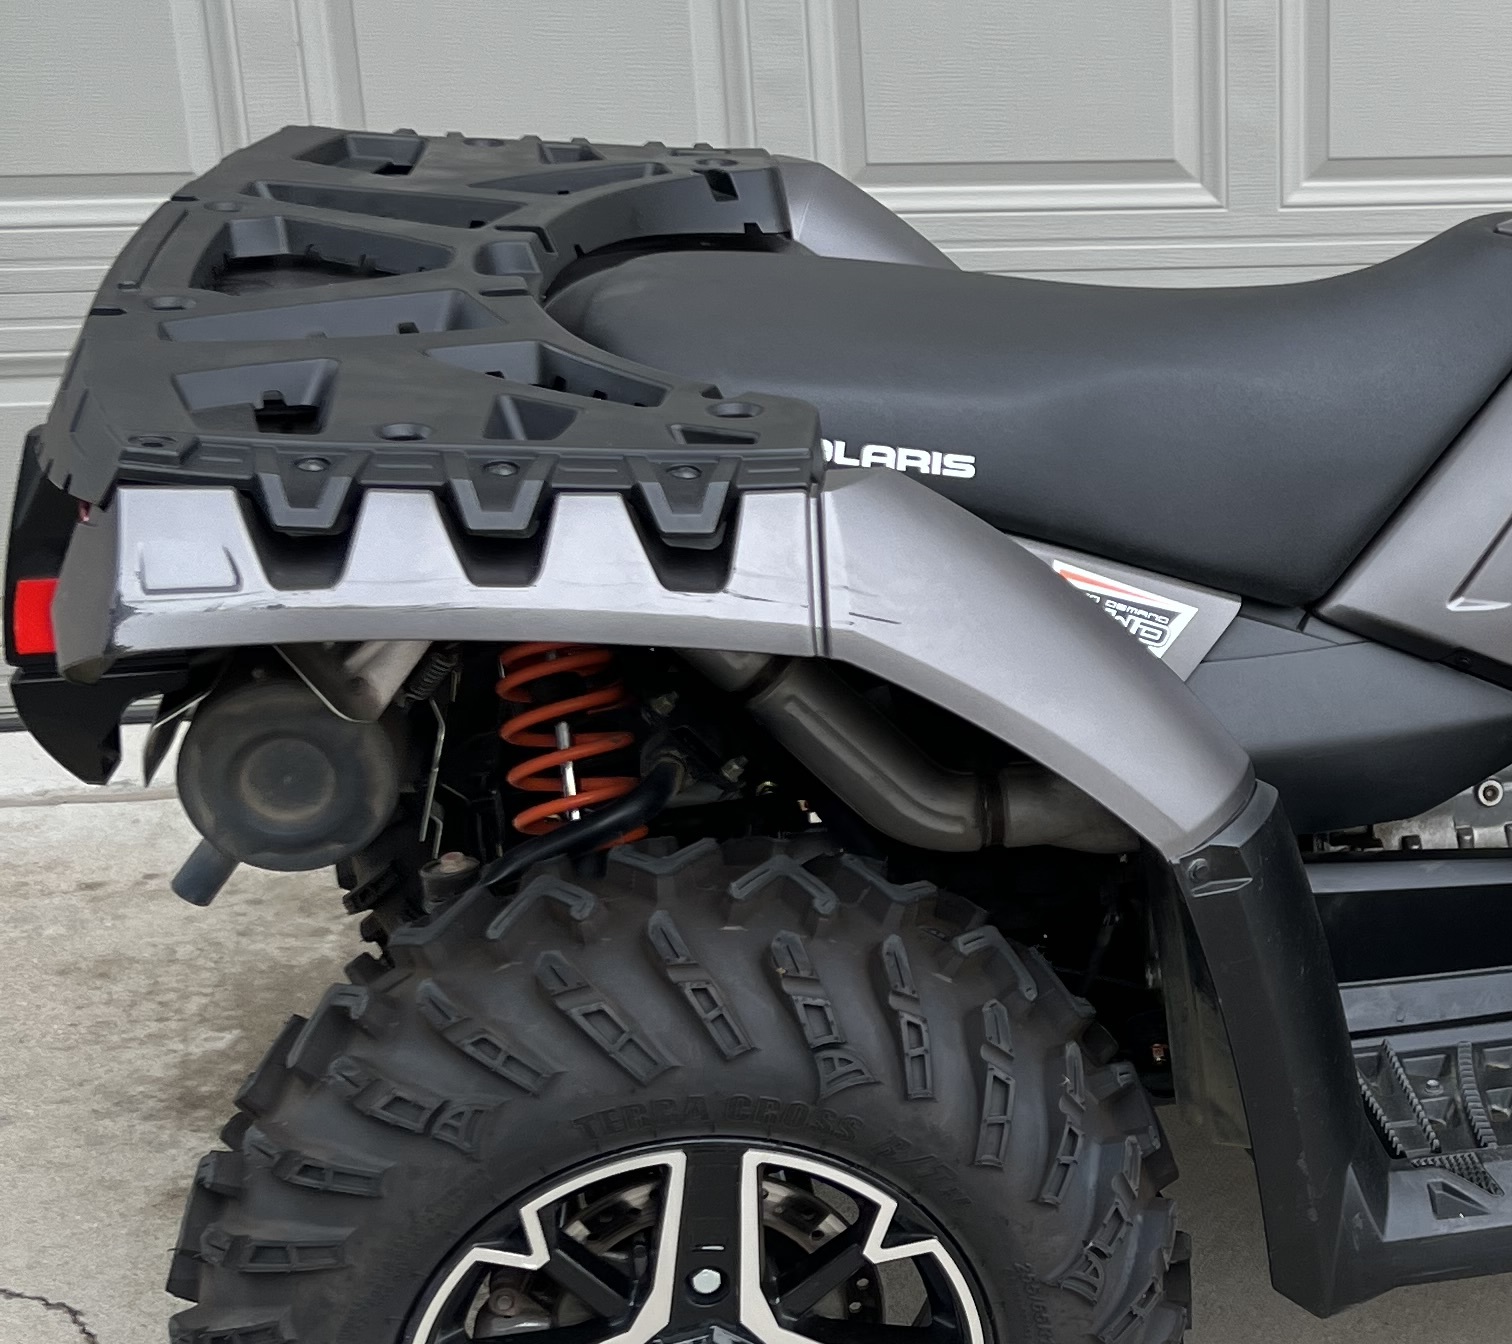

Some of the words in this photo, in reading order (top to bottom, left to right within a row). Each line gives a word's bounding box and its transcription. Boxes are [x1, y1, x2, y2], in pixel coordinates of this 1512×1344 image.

[1104, 599, 1170, 625] DEMAND
[571, 1092, 712, 1141] TERRA
[723, 1092, 866, 1143] CROSS
